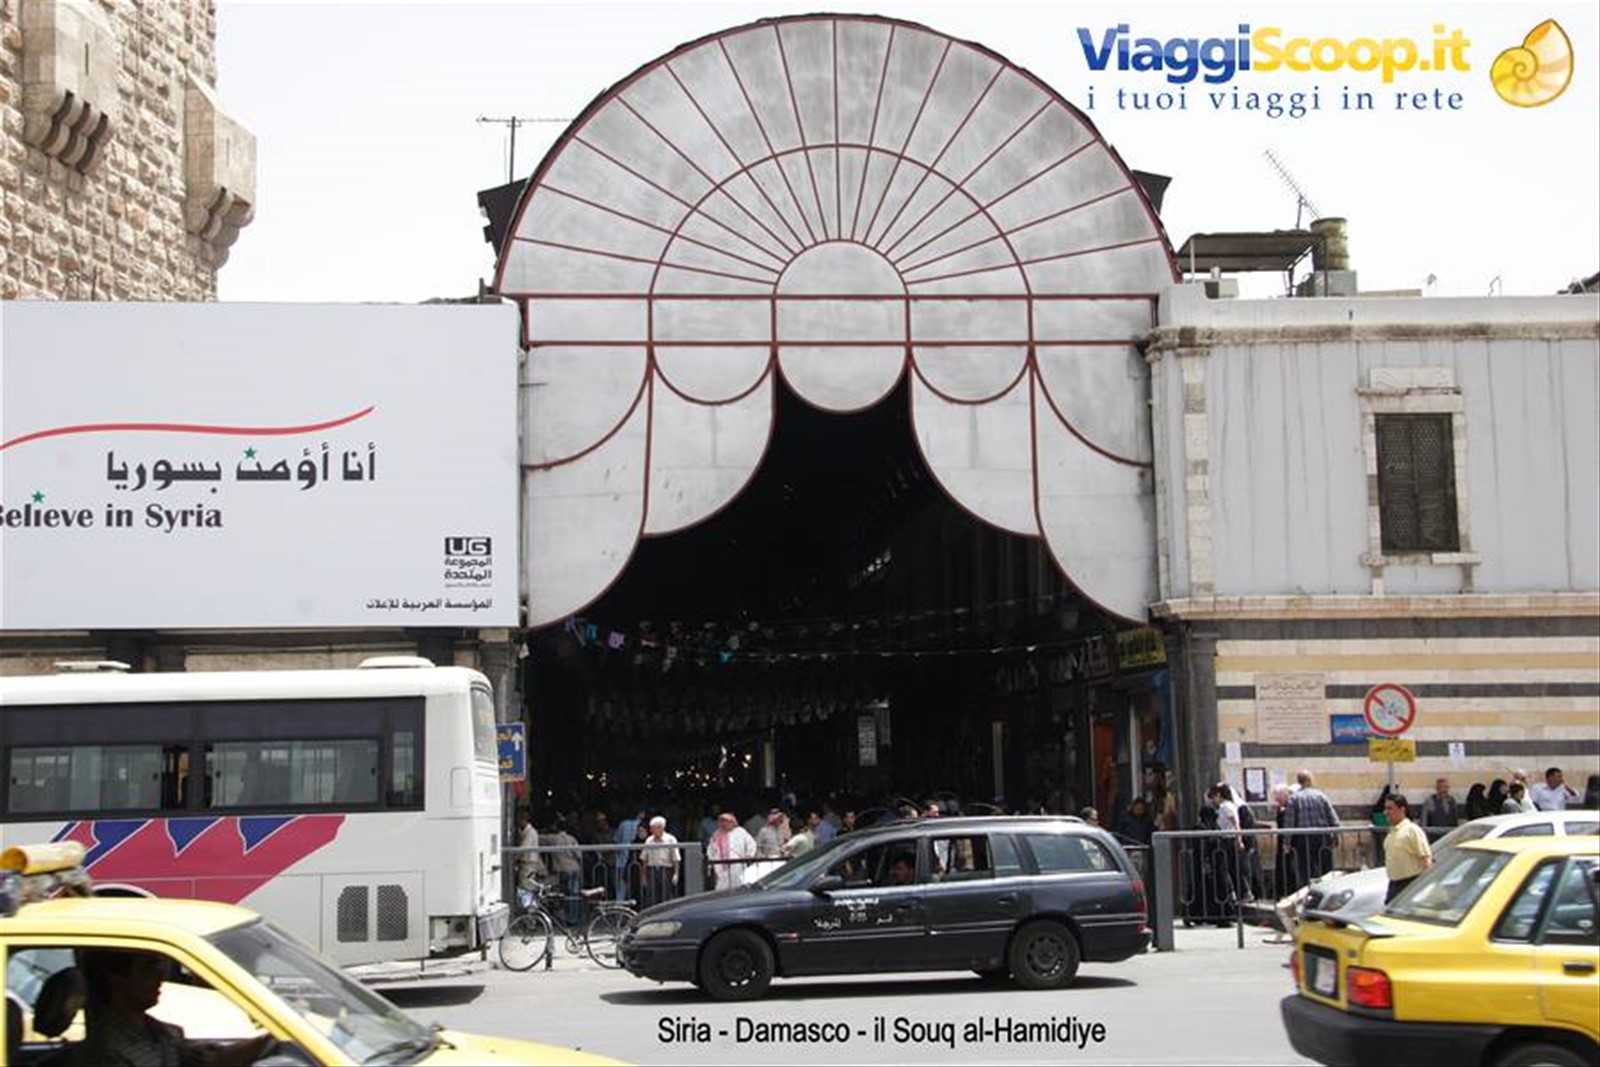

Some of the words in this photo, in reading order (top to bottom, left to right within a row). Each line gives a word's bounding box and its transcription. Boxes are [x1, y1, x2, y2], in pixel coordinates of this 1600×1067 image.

[107, 450, 222, 494] بسوريا
[343, 441, 375, 481] أنا
[0, 503, 94, 528] elieve
[106, 503, 133, 527] in
[145, 503, 223, 534] Syria
[445, 537, 491, 556] UG
